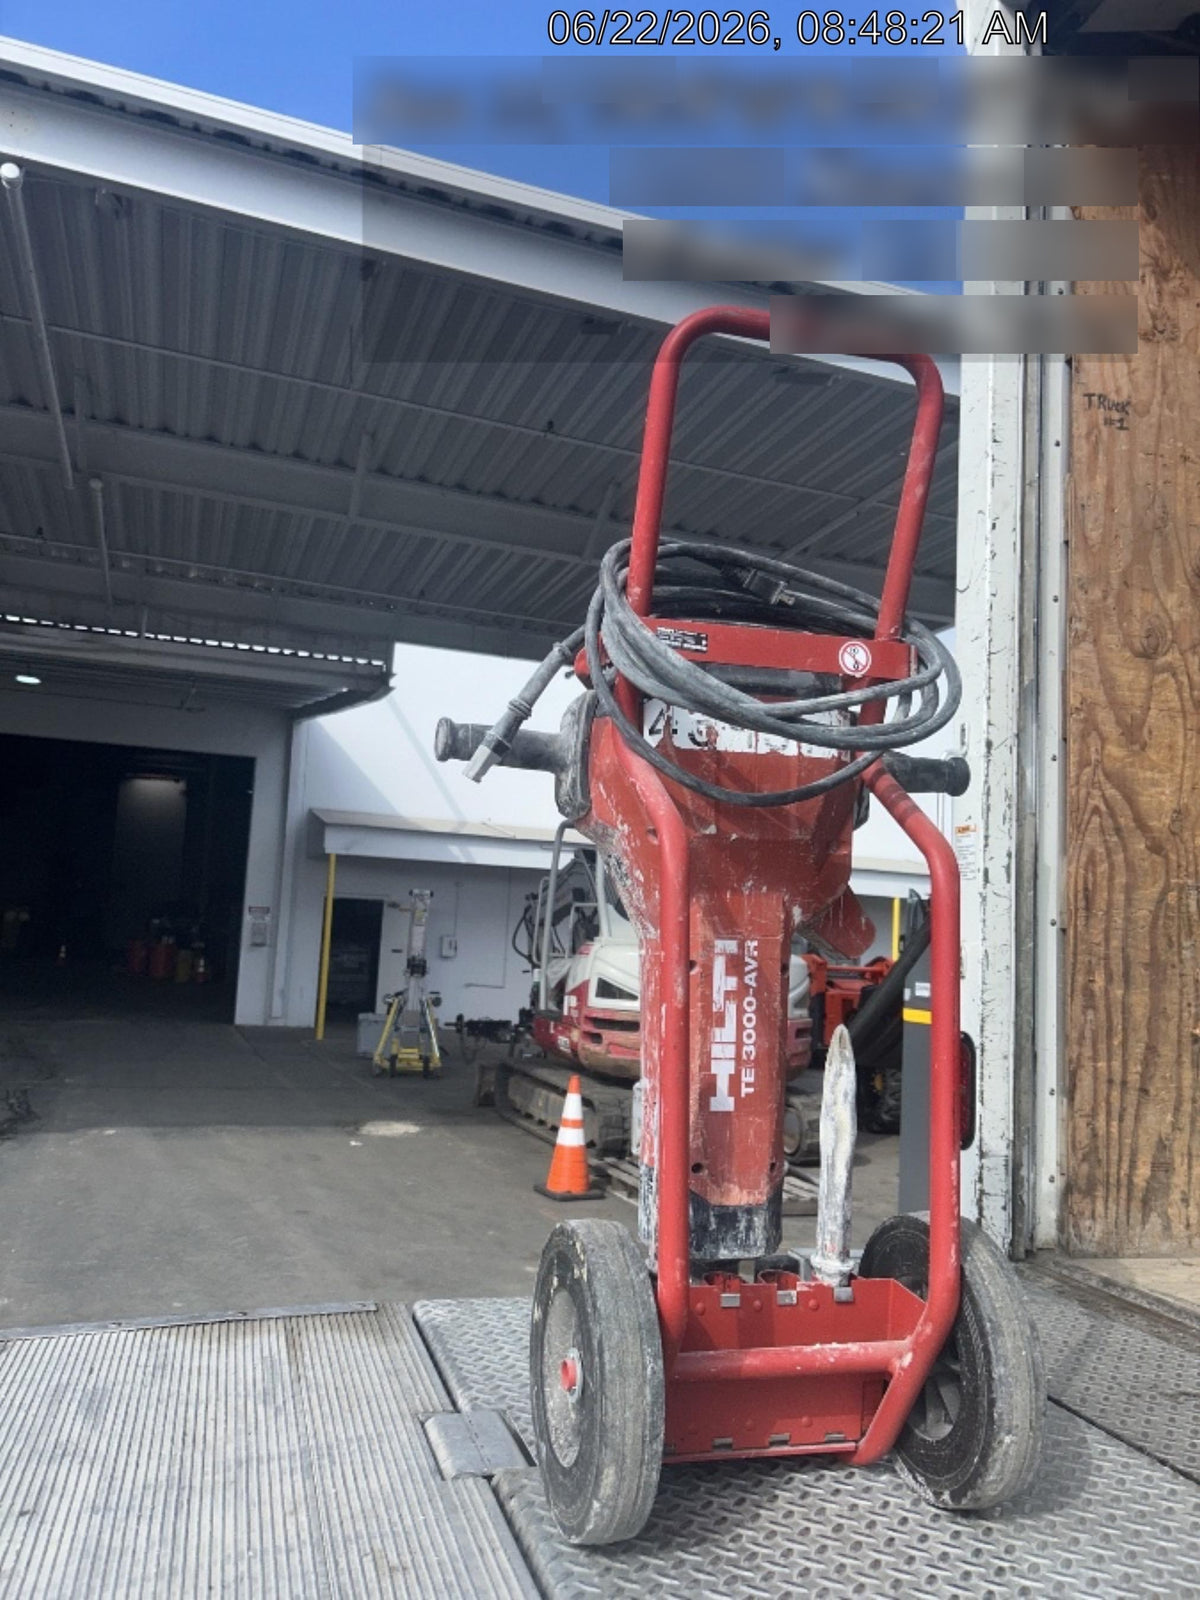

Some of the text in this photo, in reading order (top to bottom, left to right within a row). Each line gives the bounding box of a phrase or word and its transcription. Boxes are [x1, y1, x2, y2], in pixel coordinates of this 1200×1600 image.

[710, 939, 739, 1112] HILTI
[741, 939, 759, 1098] TE 3000-AVR
